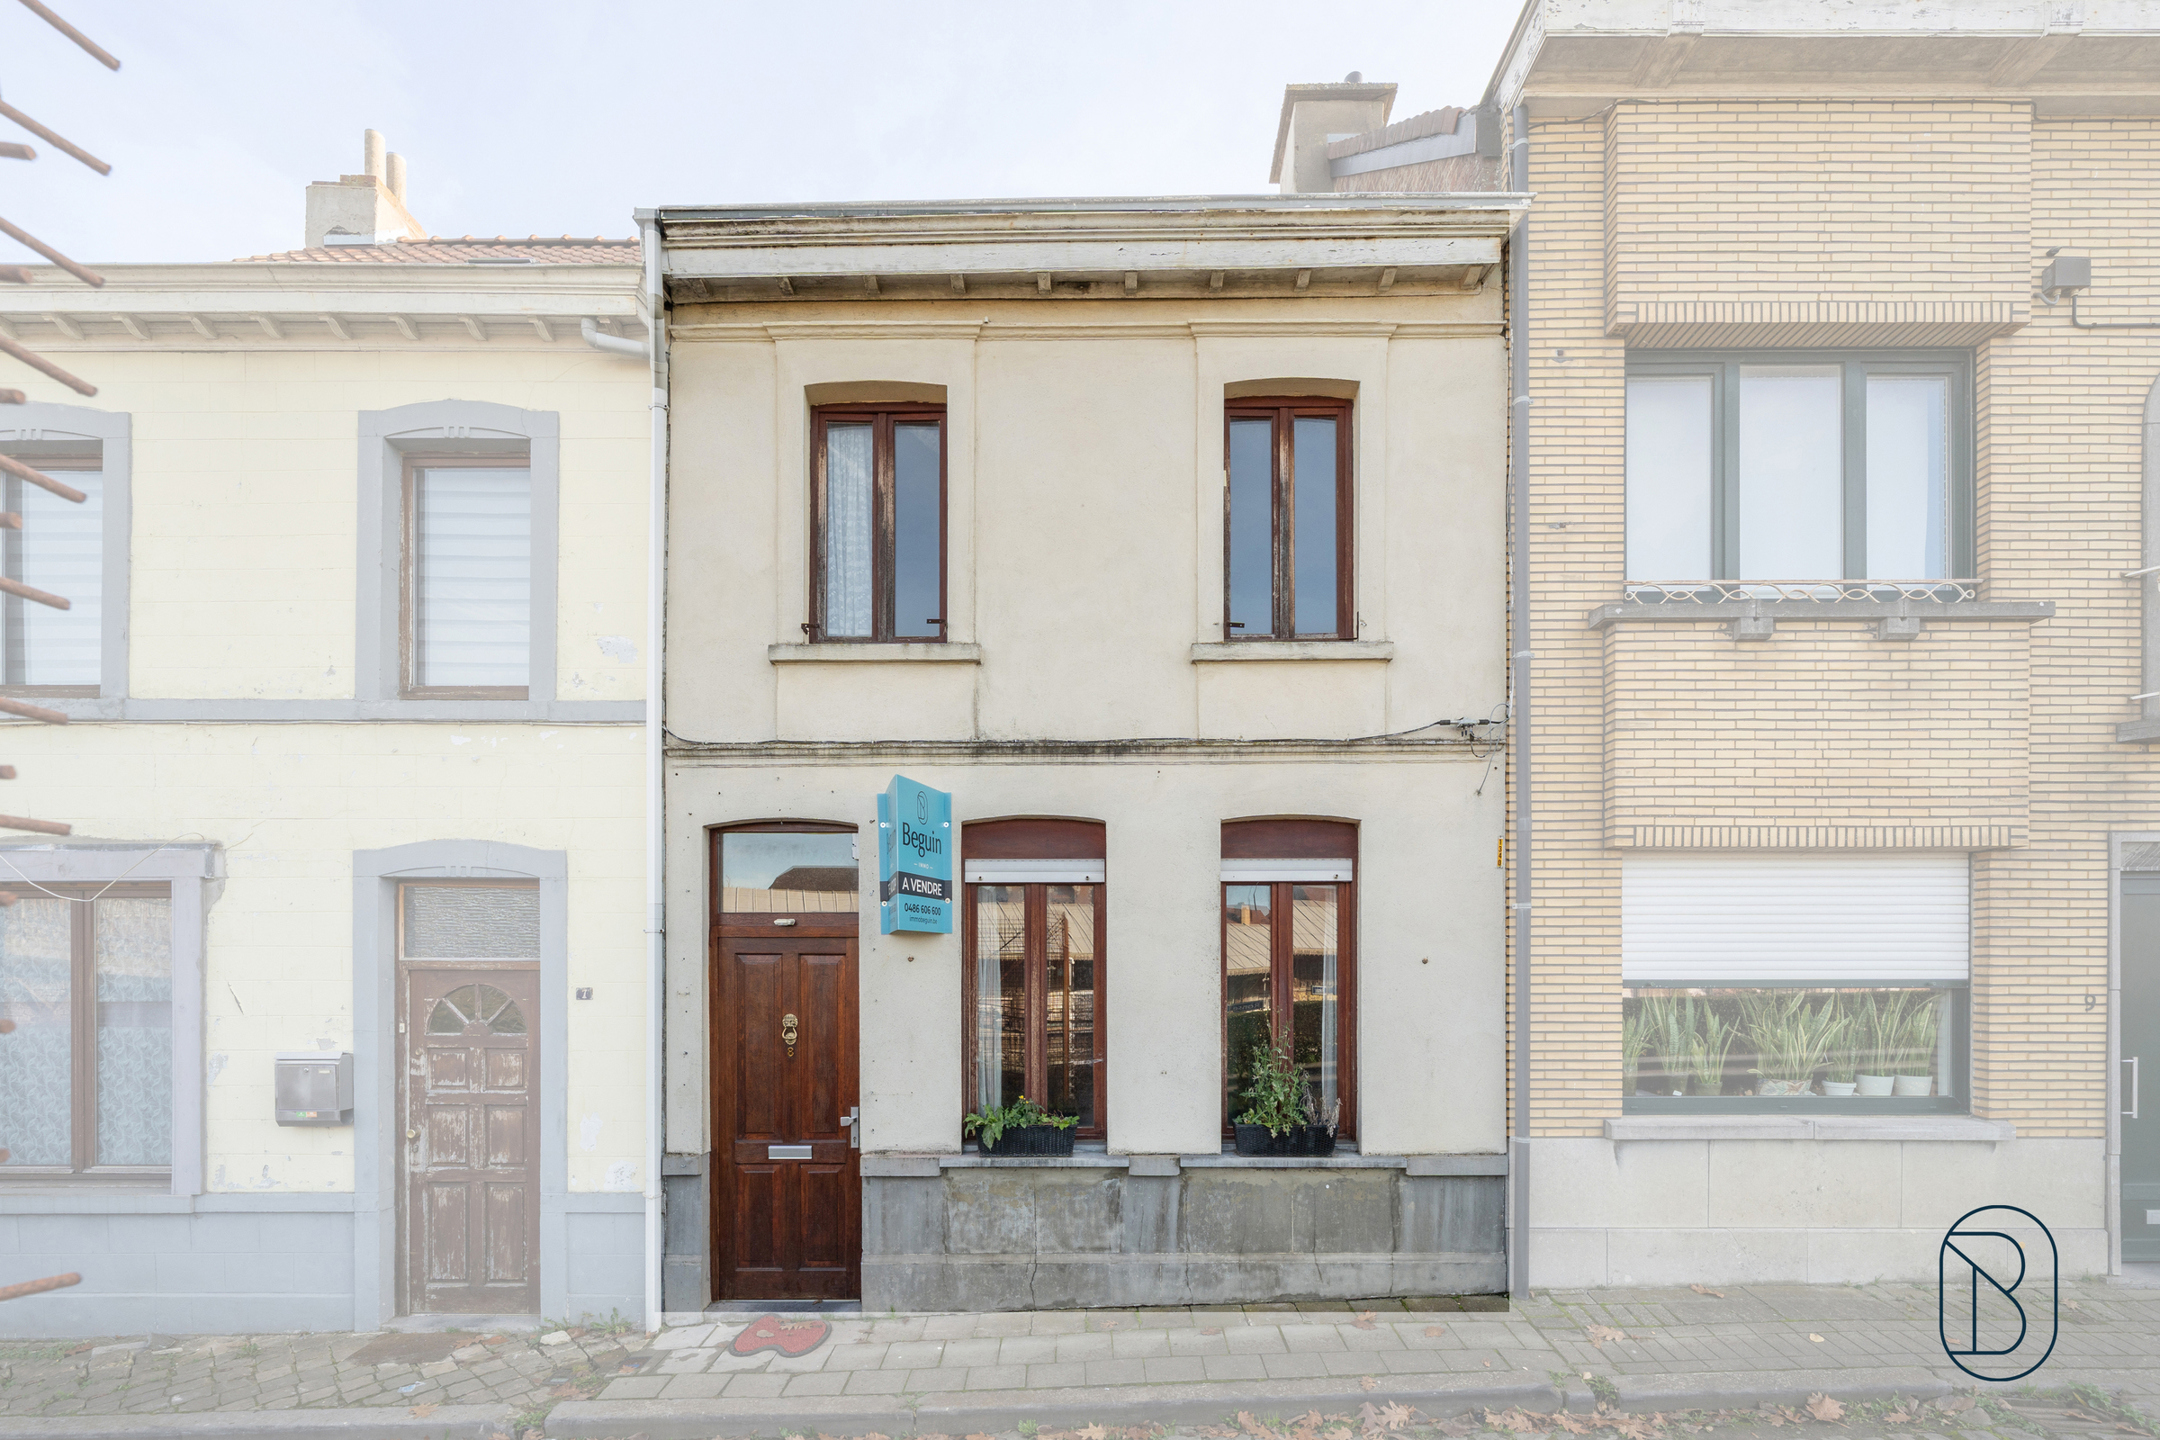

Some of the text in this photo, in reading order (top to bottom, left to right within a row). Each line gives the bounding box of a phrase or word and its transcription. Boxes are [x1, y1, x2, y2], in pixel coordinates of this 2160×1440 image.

[902, 822, 942, 858] Beguin
[902, 877, 910, 891] A
[910, 878, 943, 896] VENDRE
[904, 902, 920, 913] 0486
[921, 904, 931, 915] 606
[931, 906, 942, 916] 600
[2084, 994, 2097, 1012] 9
